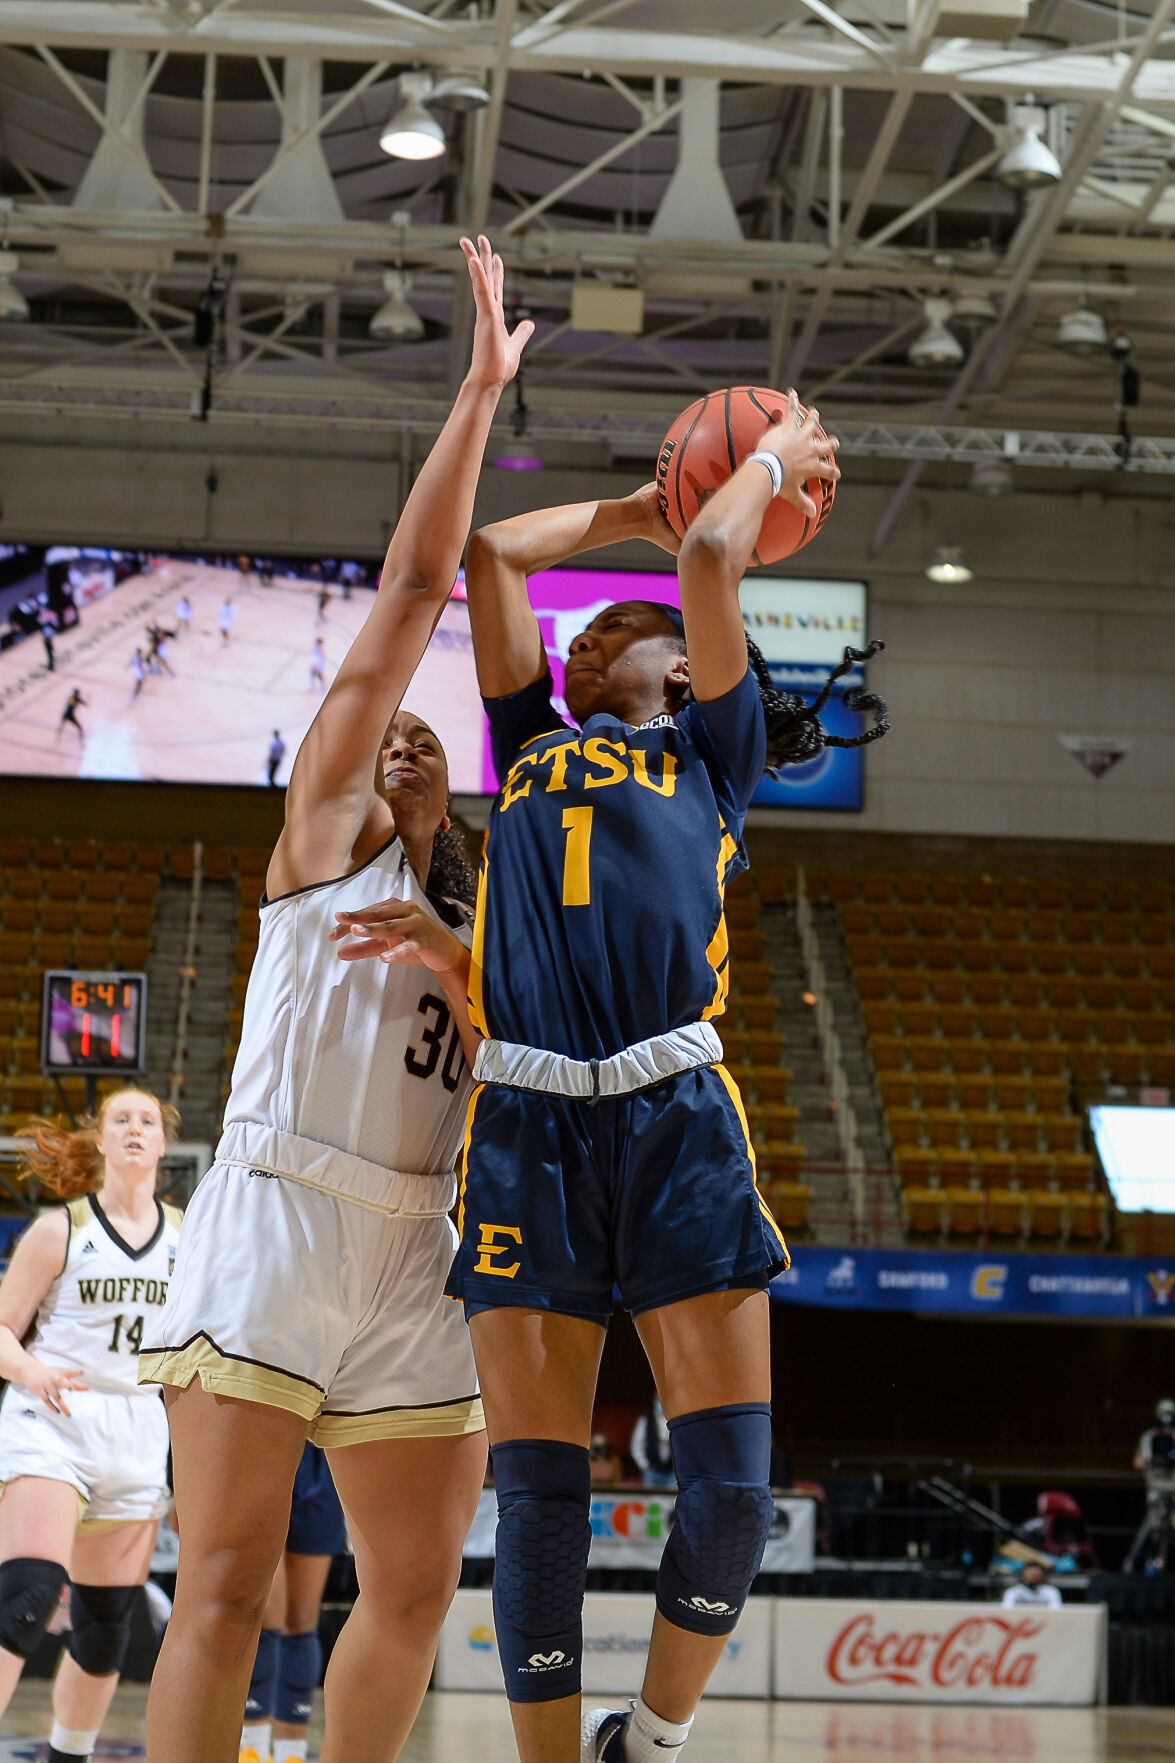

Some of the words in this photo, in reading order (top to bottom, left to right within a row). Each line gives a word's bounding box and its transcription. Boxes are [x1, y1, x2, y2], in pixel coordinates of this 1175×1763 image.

[500, 737, 678, 812] ETSU
[562, 805, 593, 906] 1
[71, 981, 131, 1008] 6:41
[473, 1222, 523, 1279] E
[108, 1315, 144, 1355] 14
[825, 1613, 1047, 1688] Coca-Cola
